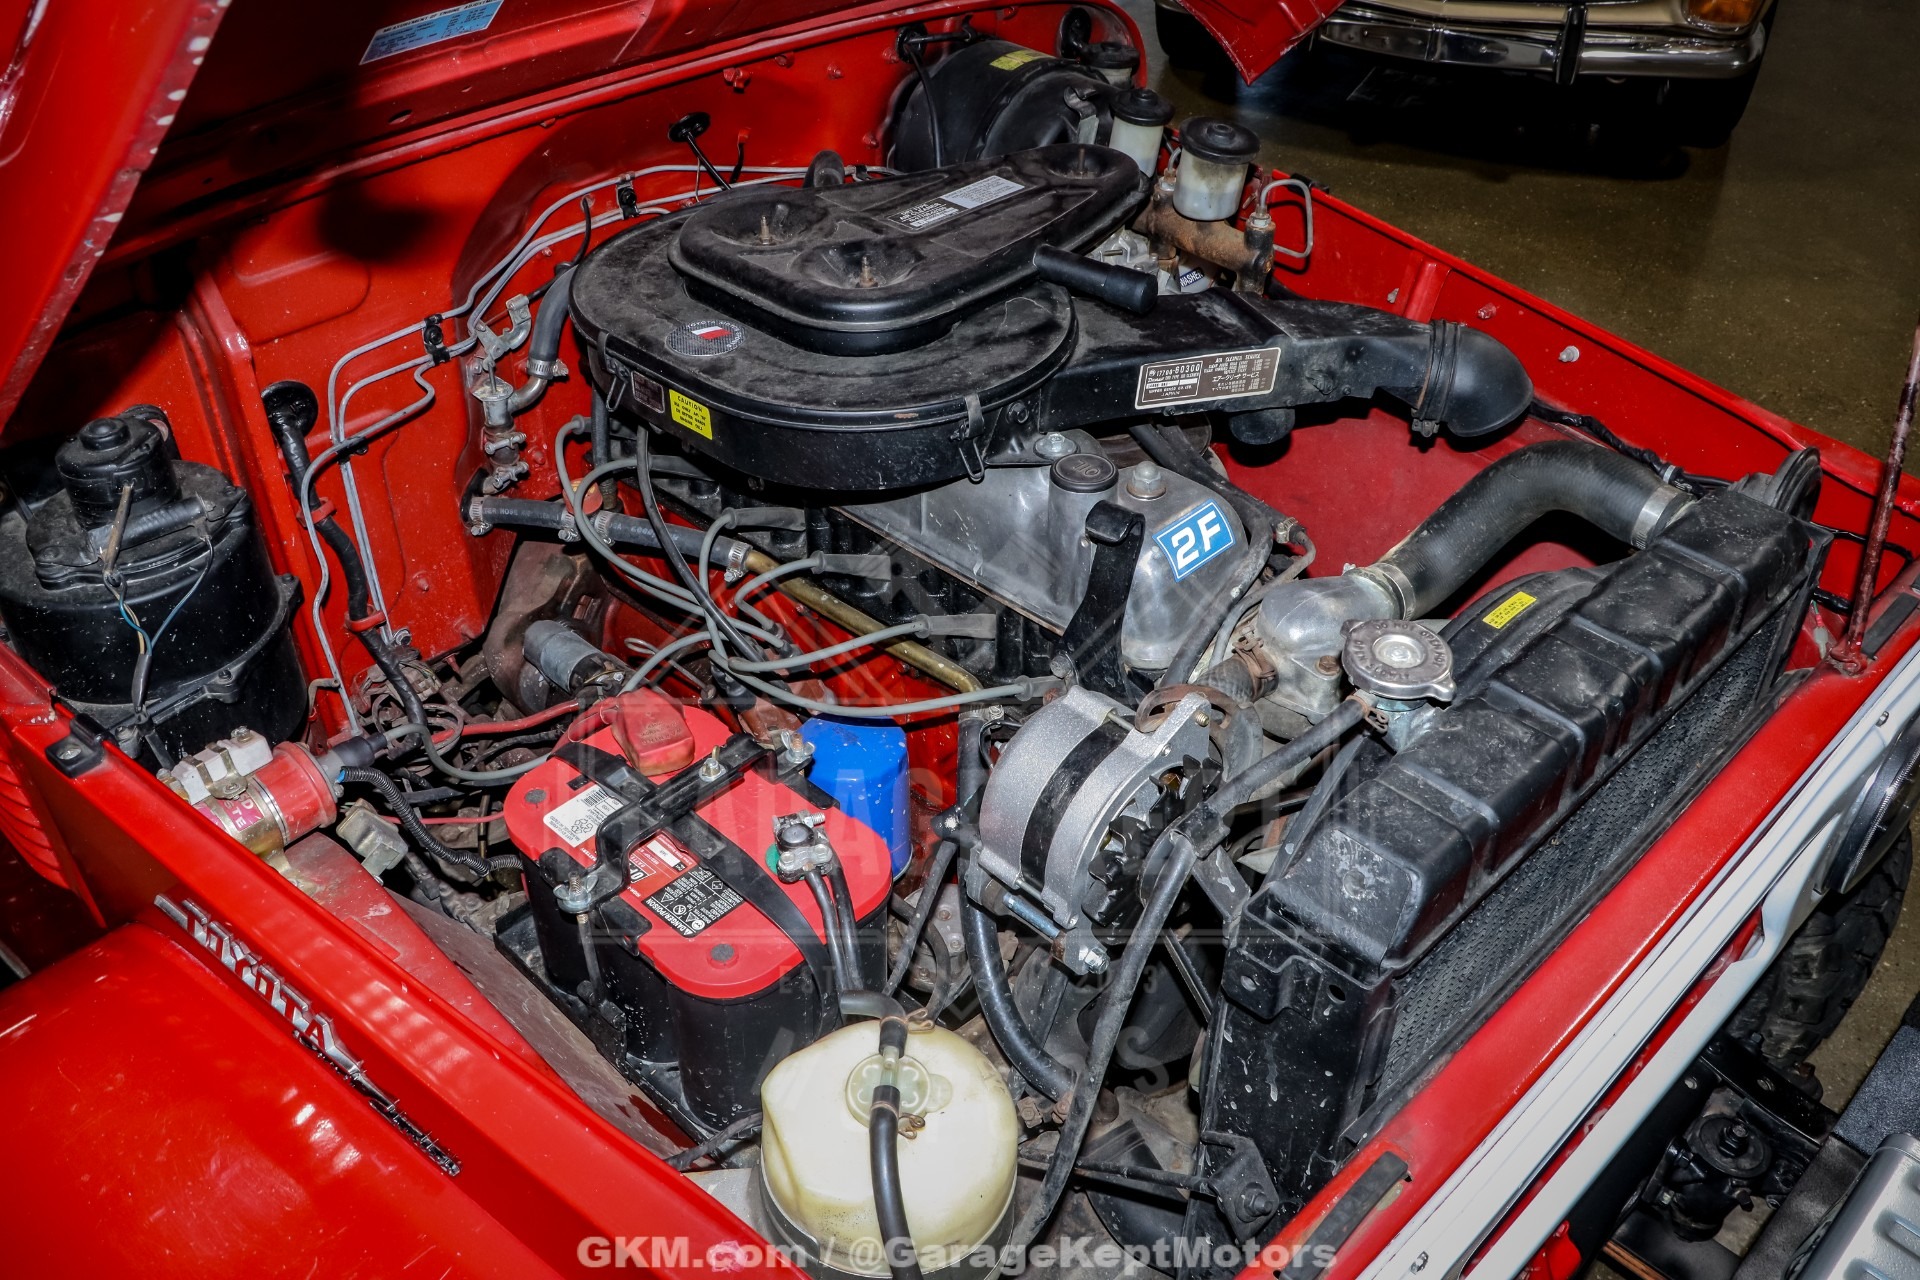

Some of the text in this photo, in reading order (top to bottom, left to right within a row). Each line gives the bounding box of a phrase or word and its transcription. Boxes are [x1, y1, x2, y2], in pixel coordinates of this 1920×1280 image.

[677, 395, 702, 413] CAUTION
[1073, 460, 1101, 477] OIL
[1171, 510, 1220, 570] 2F
[643, 898, 687, 931] DANGER/POISON
